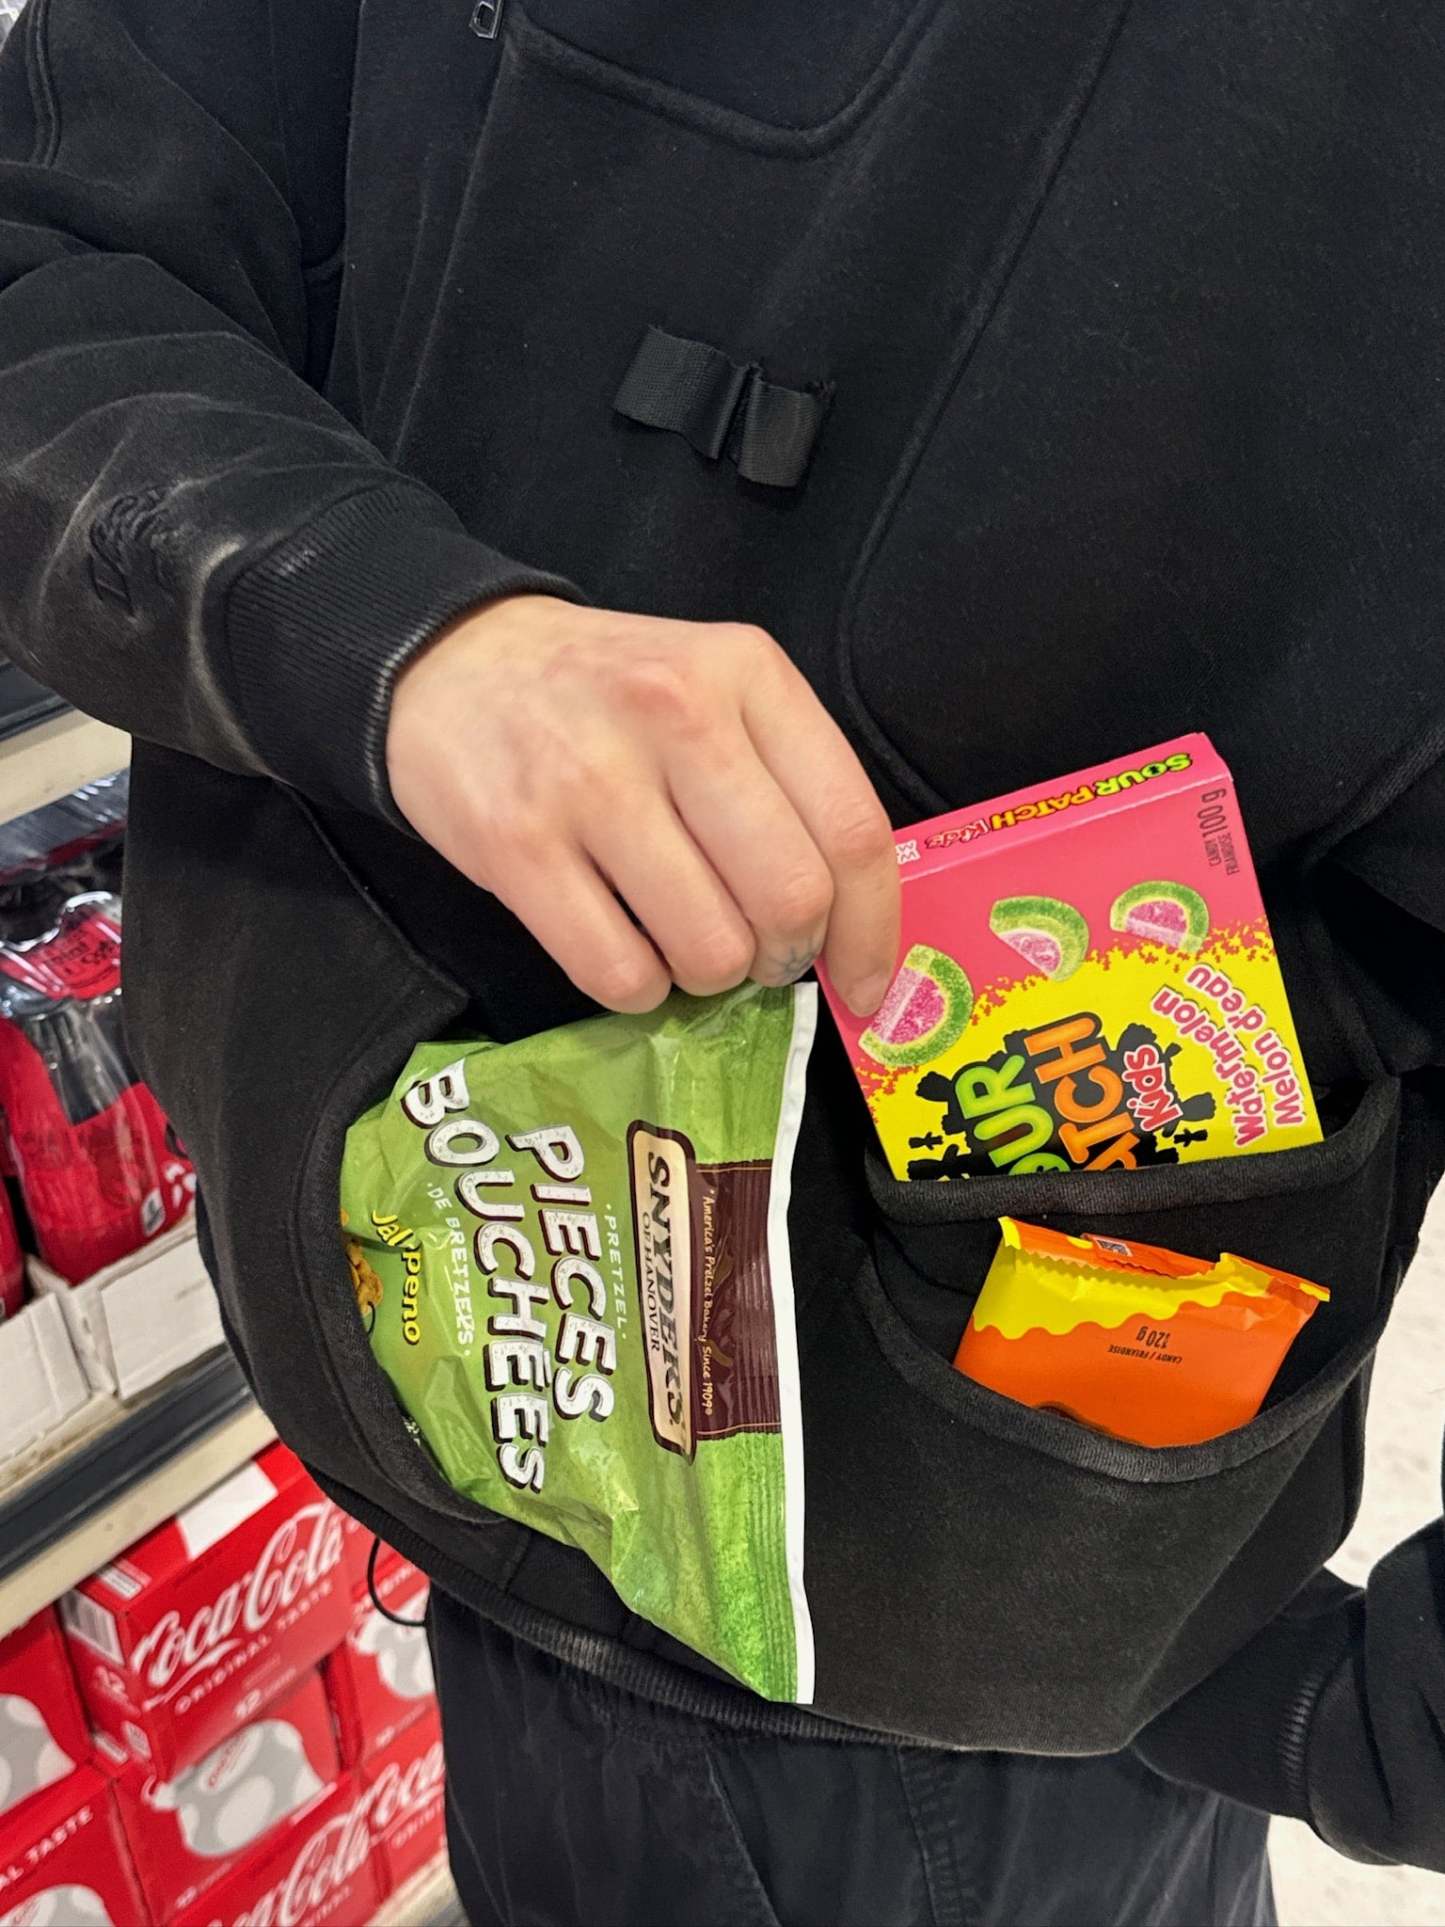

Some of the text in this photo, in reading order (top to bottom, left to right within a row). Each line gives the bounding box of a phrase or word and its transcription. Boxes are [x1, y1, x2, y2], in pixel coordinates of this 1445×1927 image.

[1095, 752, 1193, 797] SOUR
[1201, 788, 1227, 803] g
[989, 785, 1096, 830] PATCH
[1197, 805, 1228, 838] 100
[1152, 988, 1267, 1146] Watermelon
[1186, 966, 1303, 1125] Melon d'eau
[1121, 1043, 1184, 1132] Kids
[427, 1187, 453, 1210] DE
[703, 1196, 715, 1253] America's
[371, 1208, 422, 1346] Jalpeno
[401, 1057, 552, 1494] BOUCHÉES
[505, 1124, 617, 1423] PIECES
[604, 1215, 628, 1329] PRETZEL
[642, 1212, 661, 1352] OF HANOVER
[704, 1256, 716, 1298] Pretzel
[696, 1301, 712, 1342] Bakery
[1136, 1325, 1171, 1350] 120 g
[703, 1346, 712, 1379] Since
[130, 1499, 344, 1712] Coca-Cola
[174, 1633, 272, 1715] ORIGINAL
[25, 1804, 94, 1865] TASTE
